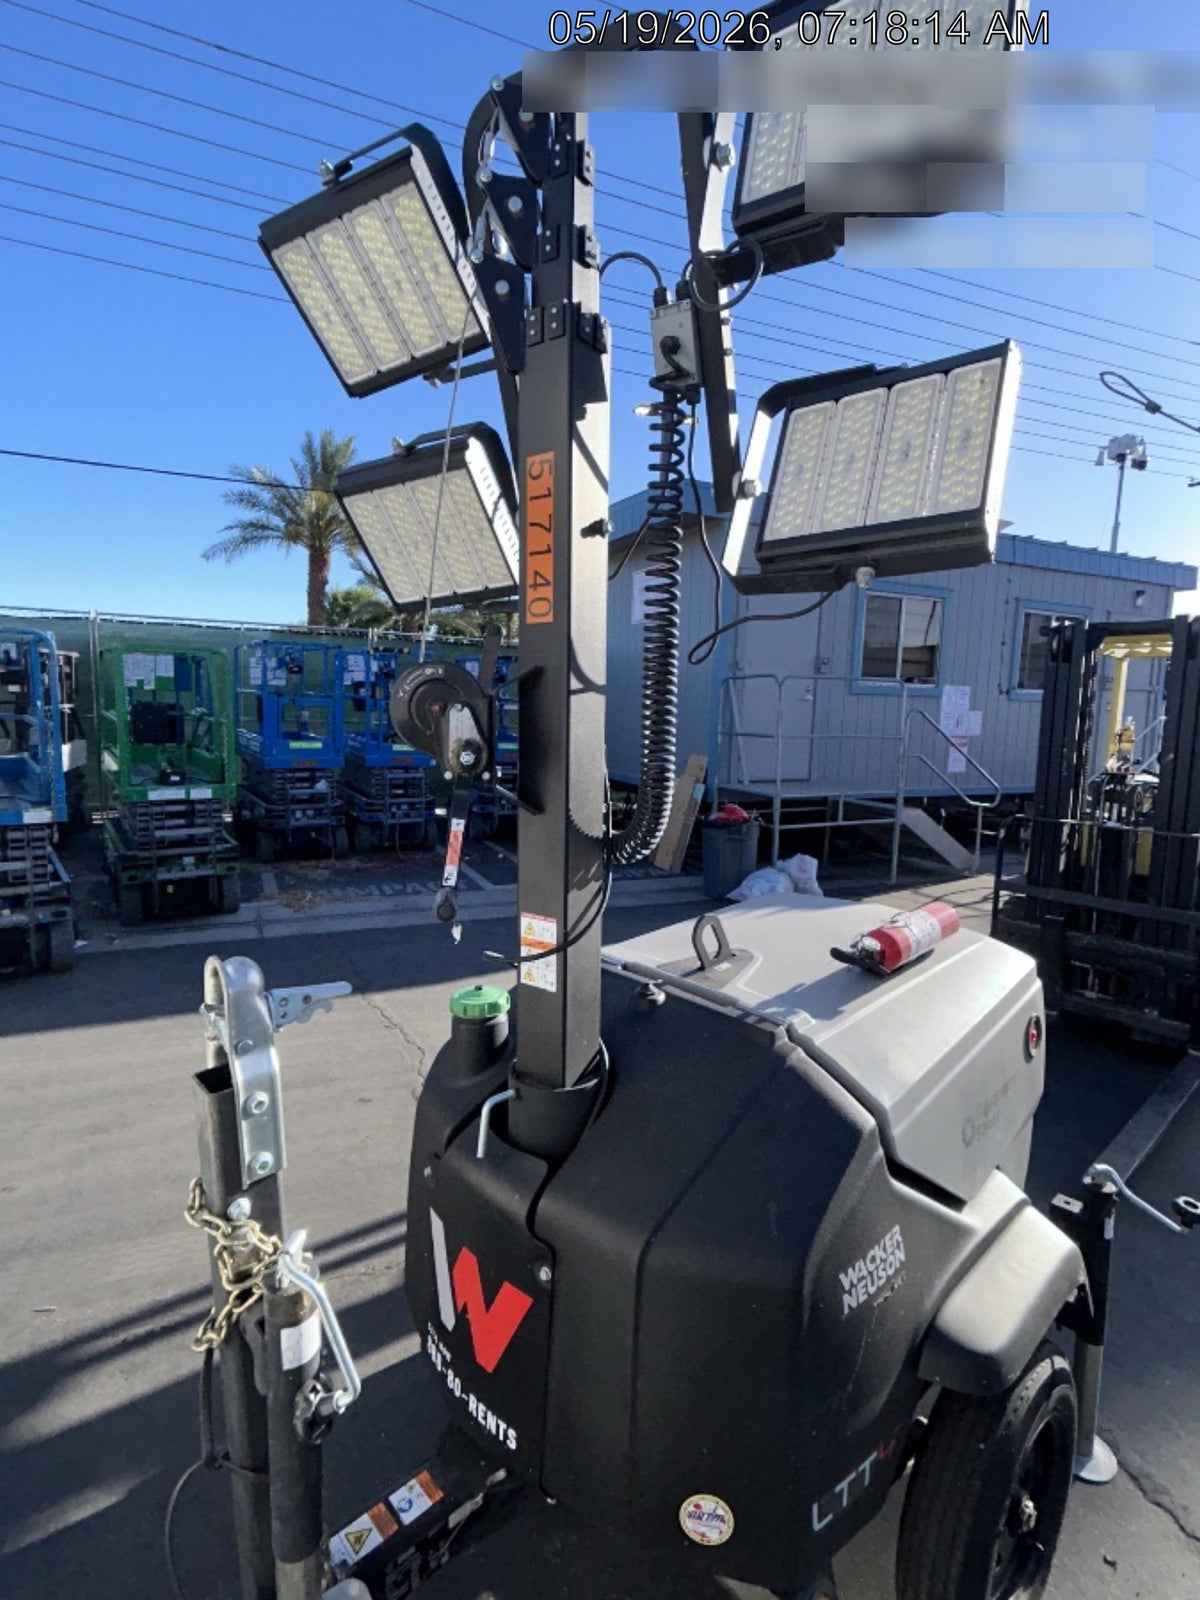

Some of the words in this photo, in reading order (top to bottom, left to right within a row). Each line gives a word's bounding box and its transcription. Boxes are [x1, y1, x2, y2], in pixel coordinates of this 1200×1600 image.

[527, 459, 553, 618] 517140
[839, 1224, 903, 1291] WACKER
[842, 1242, 906, 1315] NEUSON
